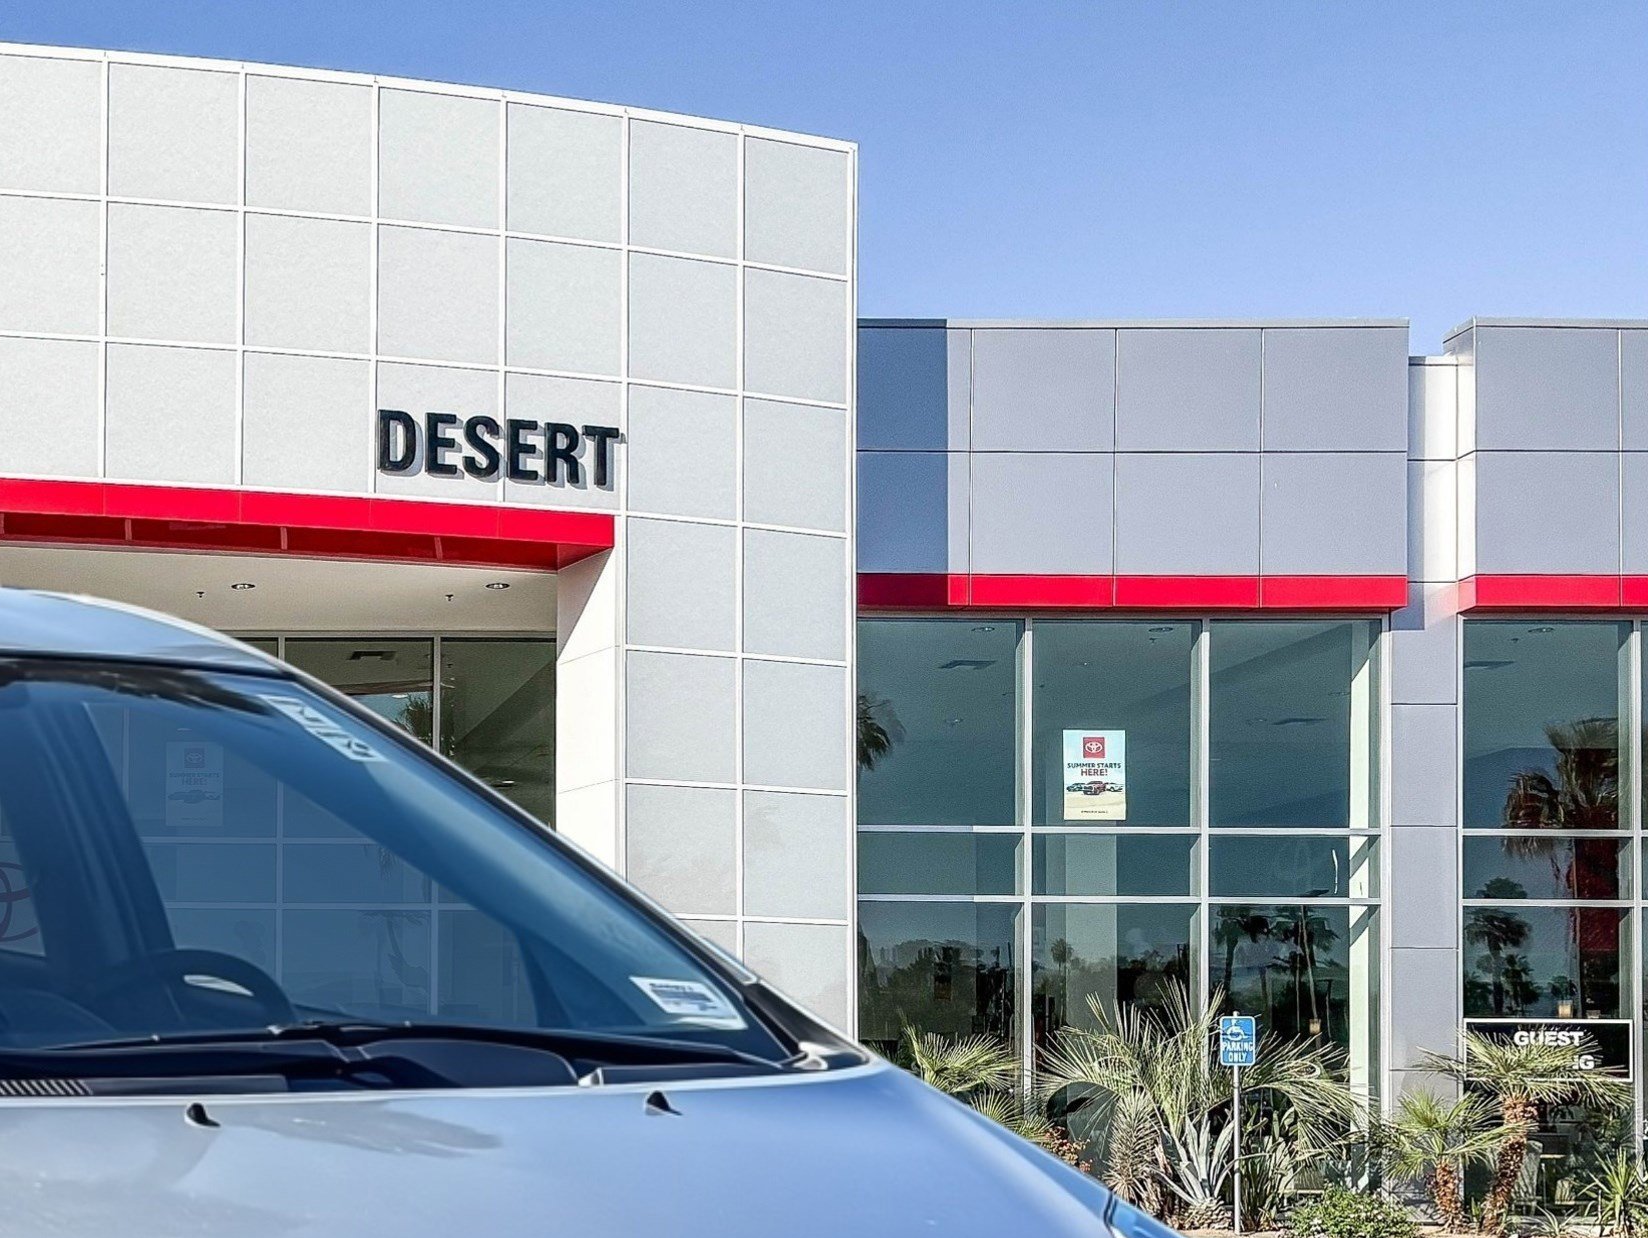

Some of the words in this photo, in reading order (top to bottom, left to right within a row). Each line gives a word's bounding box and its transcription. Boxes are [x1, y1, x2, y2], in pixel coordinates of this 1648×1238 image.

[377, 408, 620, 487] DESERT
[1513, 1031, 1584, 1046] GUEST
[1222, 1041, 1254, 1052] PARKING
[1228, 1052, 1247, 1062] ONLY
